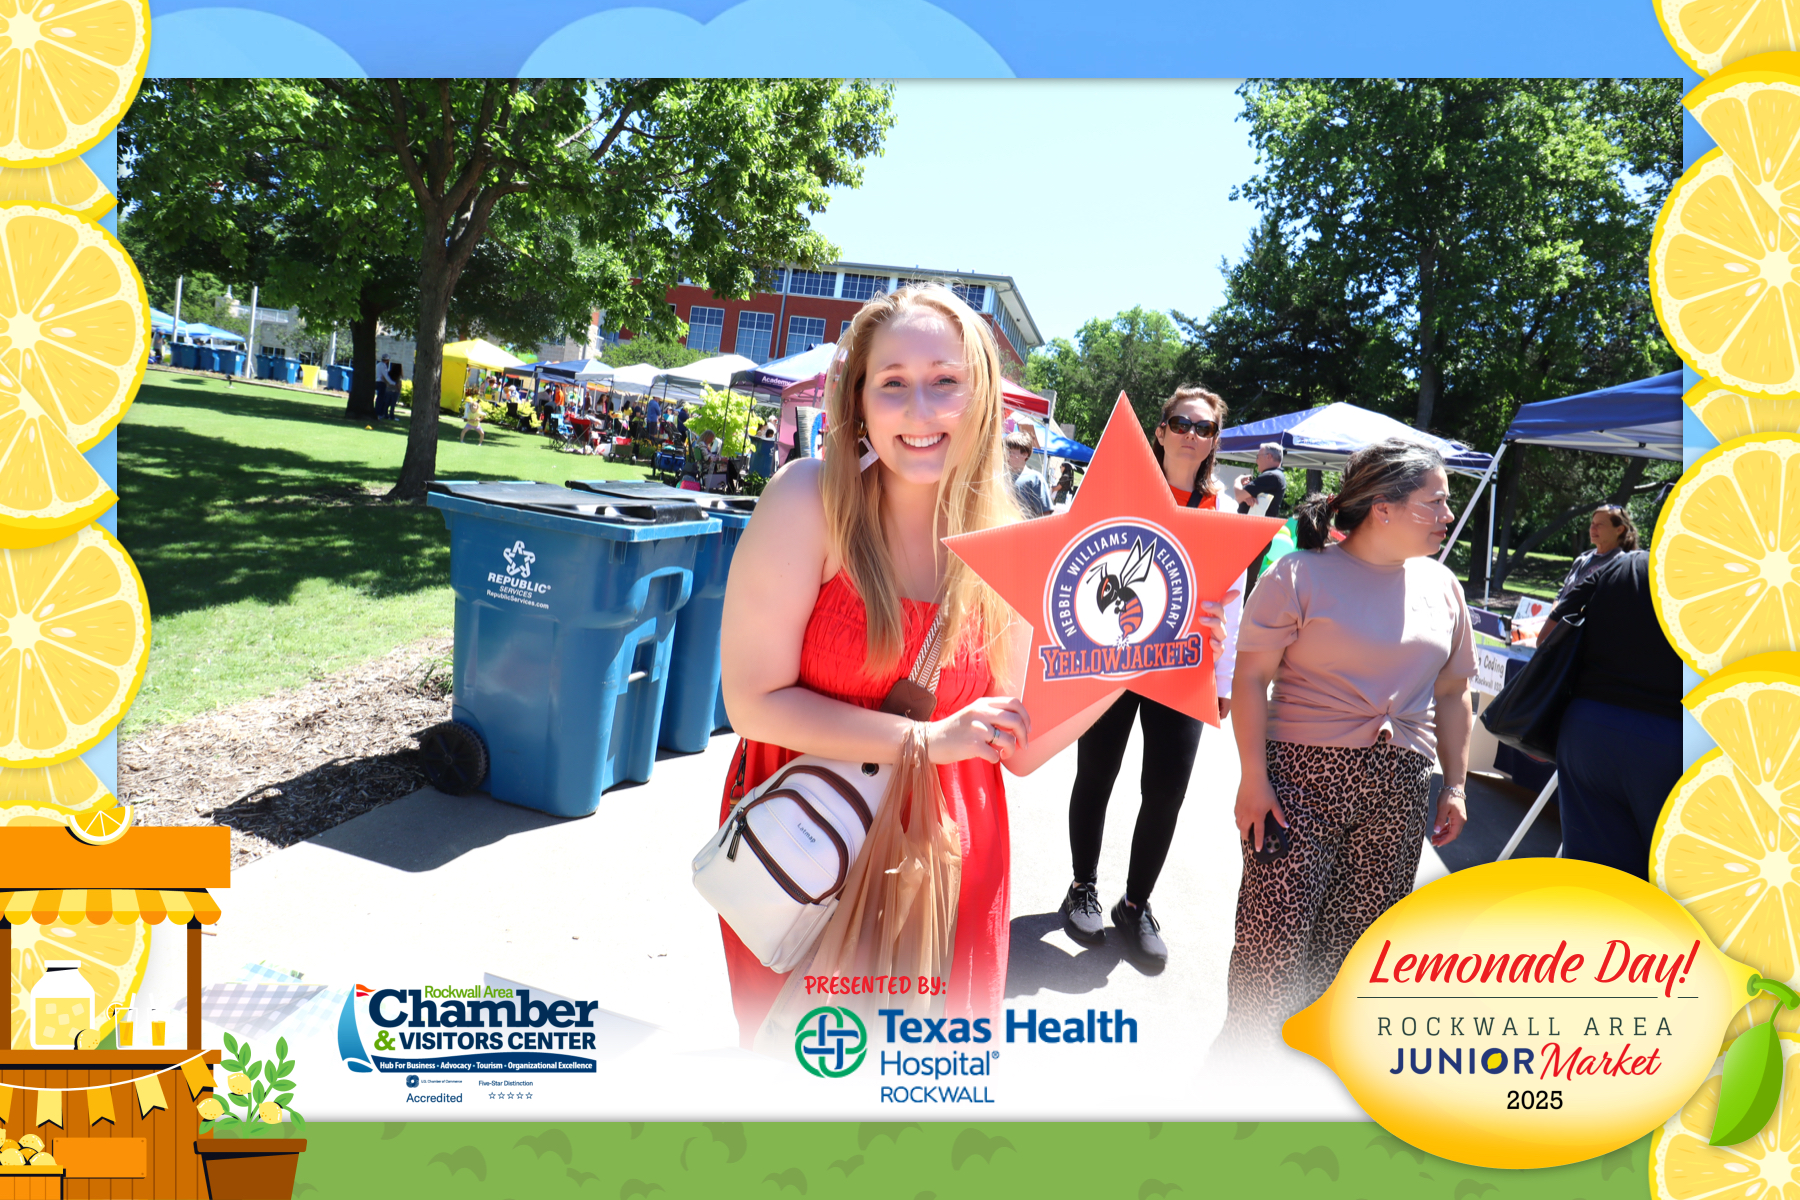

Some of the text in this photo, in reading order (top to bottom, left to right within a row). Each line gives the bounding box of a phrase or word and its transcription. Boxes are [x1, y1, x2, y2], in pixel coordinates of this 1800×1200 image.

[499, 585, 532, 599] SERVICES
[1059, 532, 1183, 637] NEBBIE WILLIAMS ELEMENTARY
[486, 589, 549, 609] RepublicServices.com
[1043, 637, 1199, 677] YELLOWJACKETS
[1483, 654, 1504, 678] Coding
